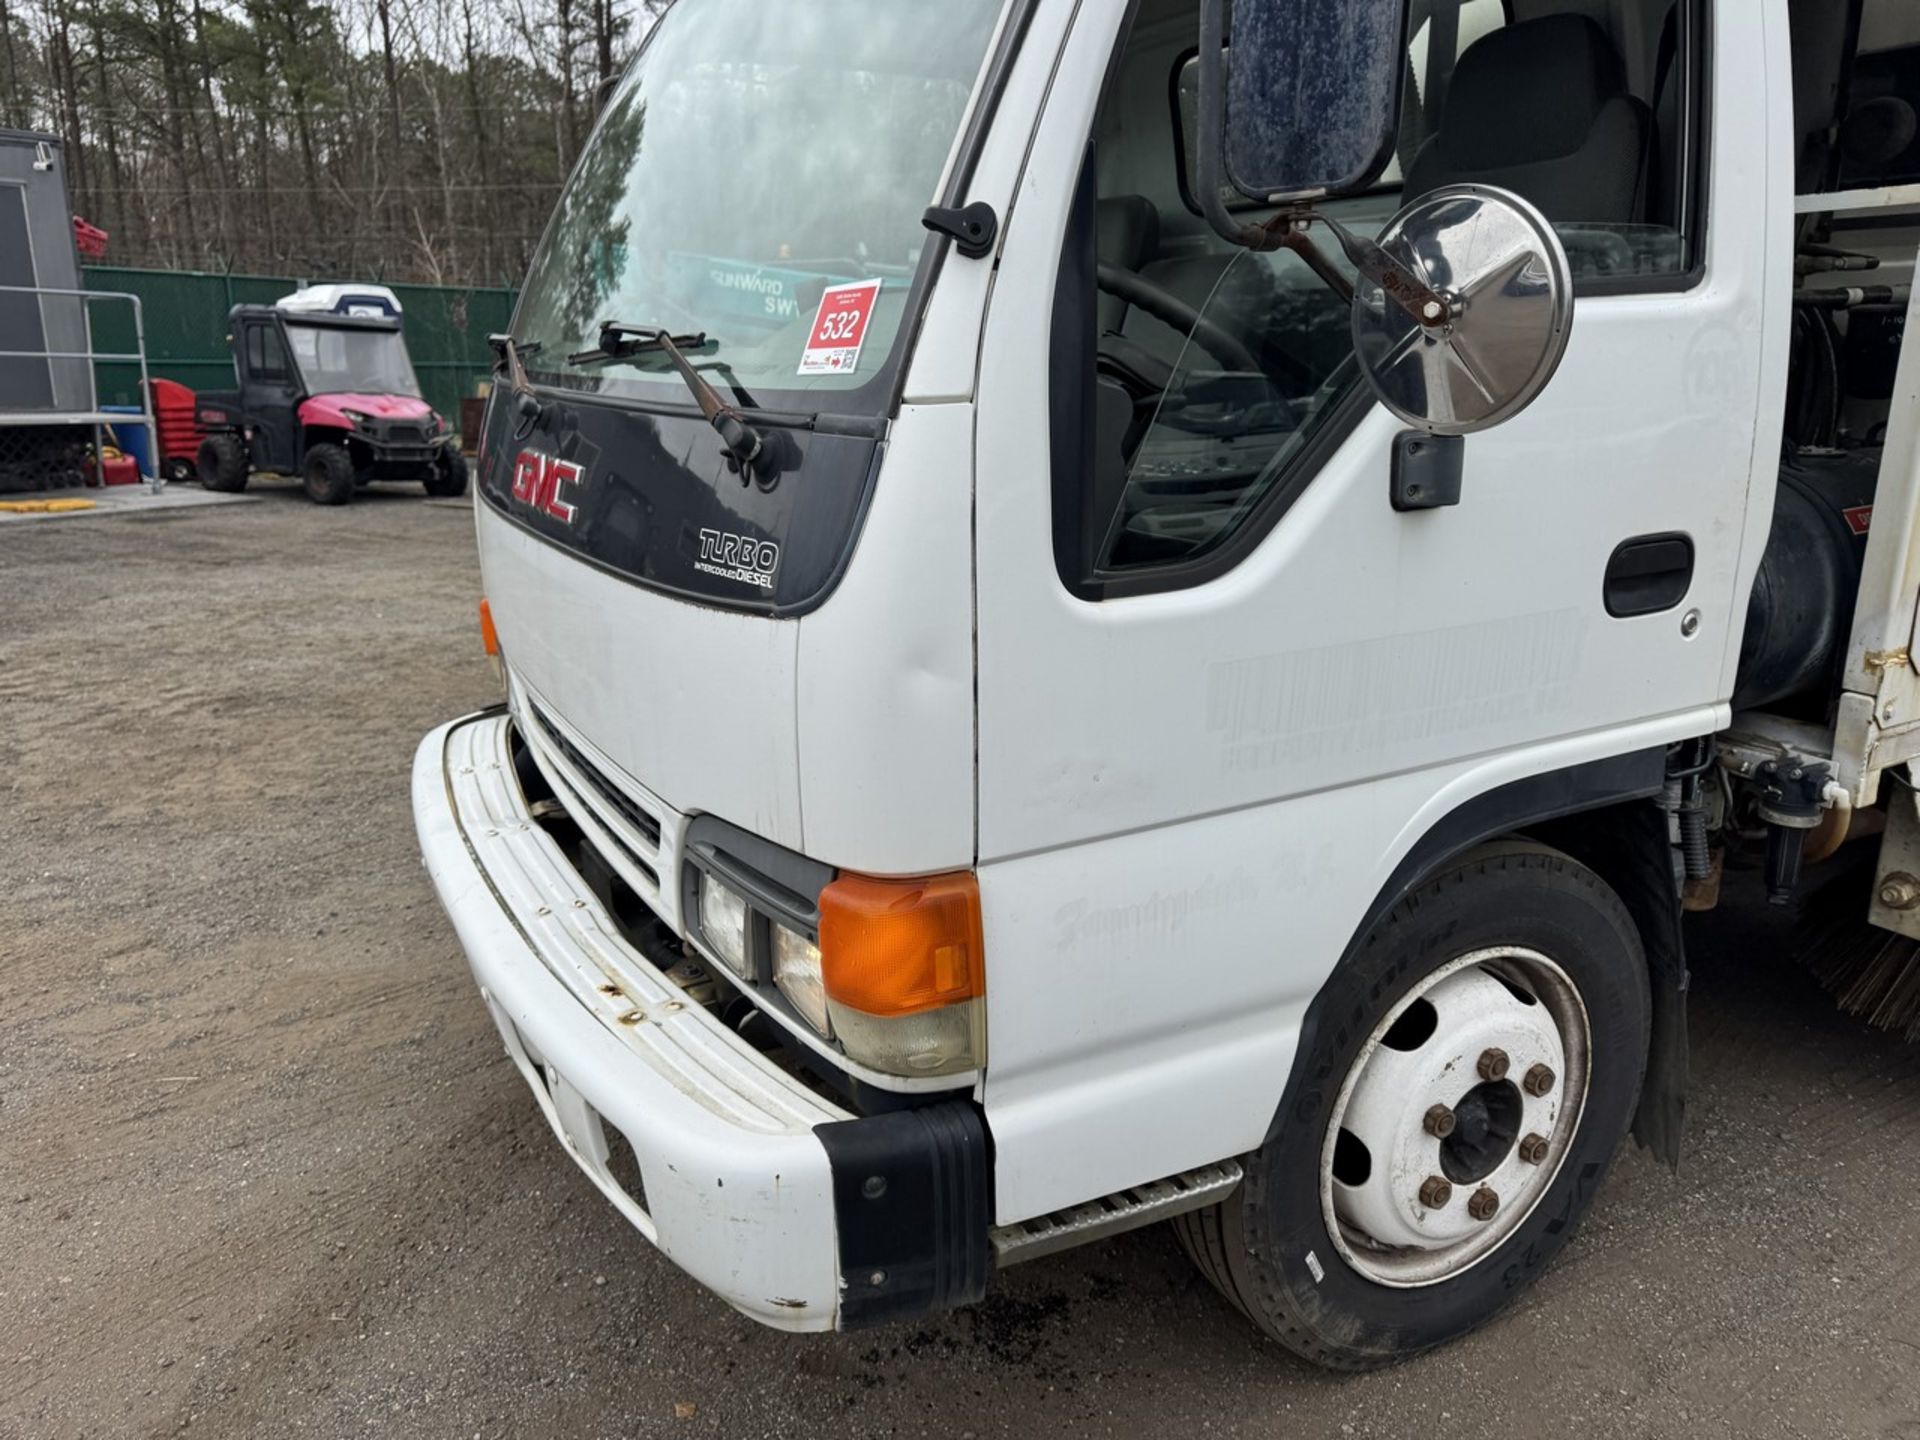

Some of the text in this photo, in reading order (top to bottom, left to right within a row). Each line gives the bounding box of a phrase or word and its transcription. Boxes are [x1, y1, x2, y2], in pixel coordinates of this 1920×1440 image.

[820, 310, 861, 341] 532
[512, 448, 585, 524] GMC
[699, 528, 779, 575] TURBO
[736, 568, 773, 588] DIESEL
